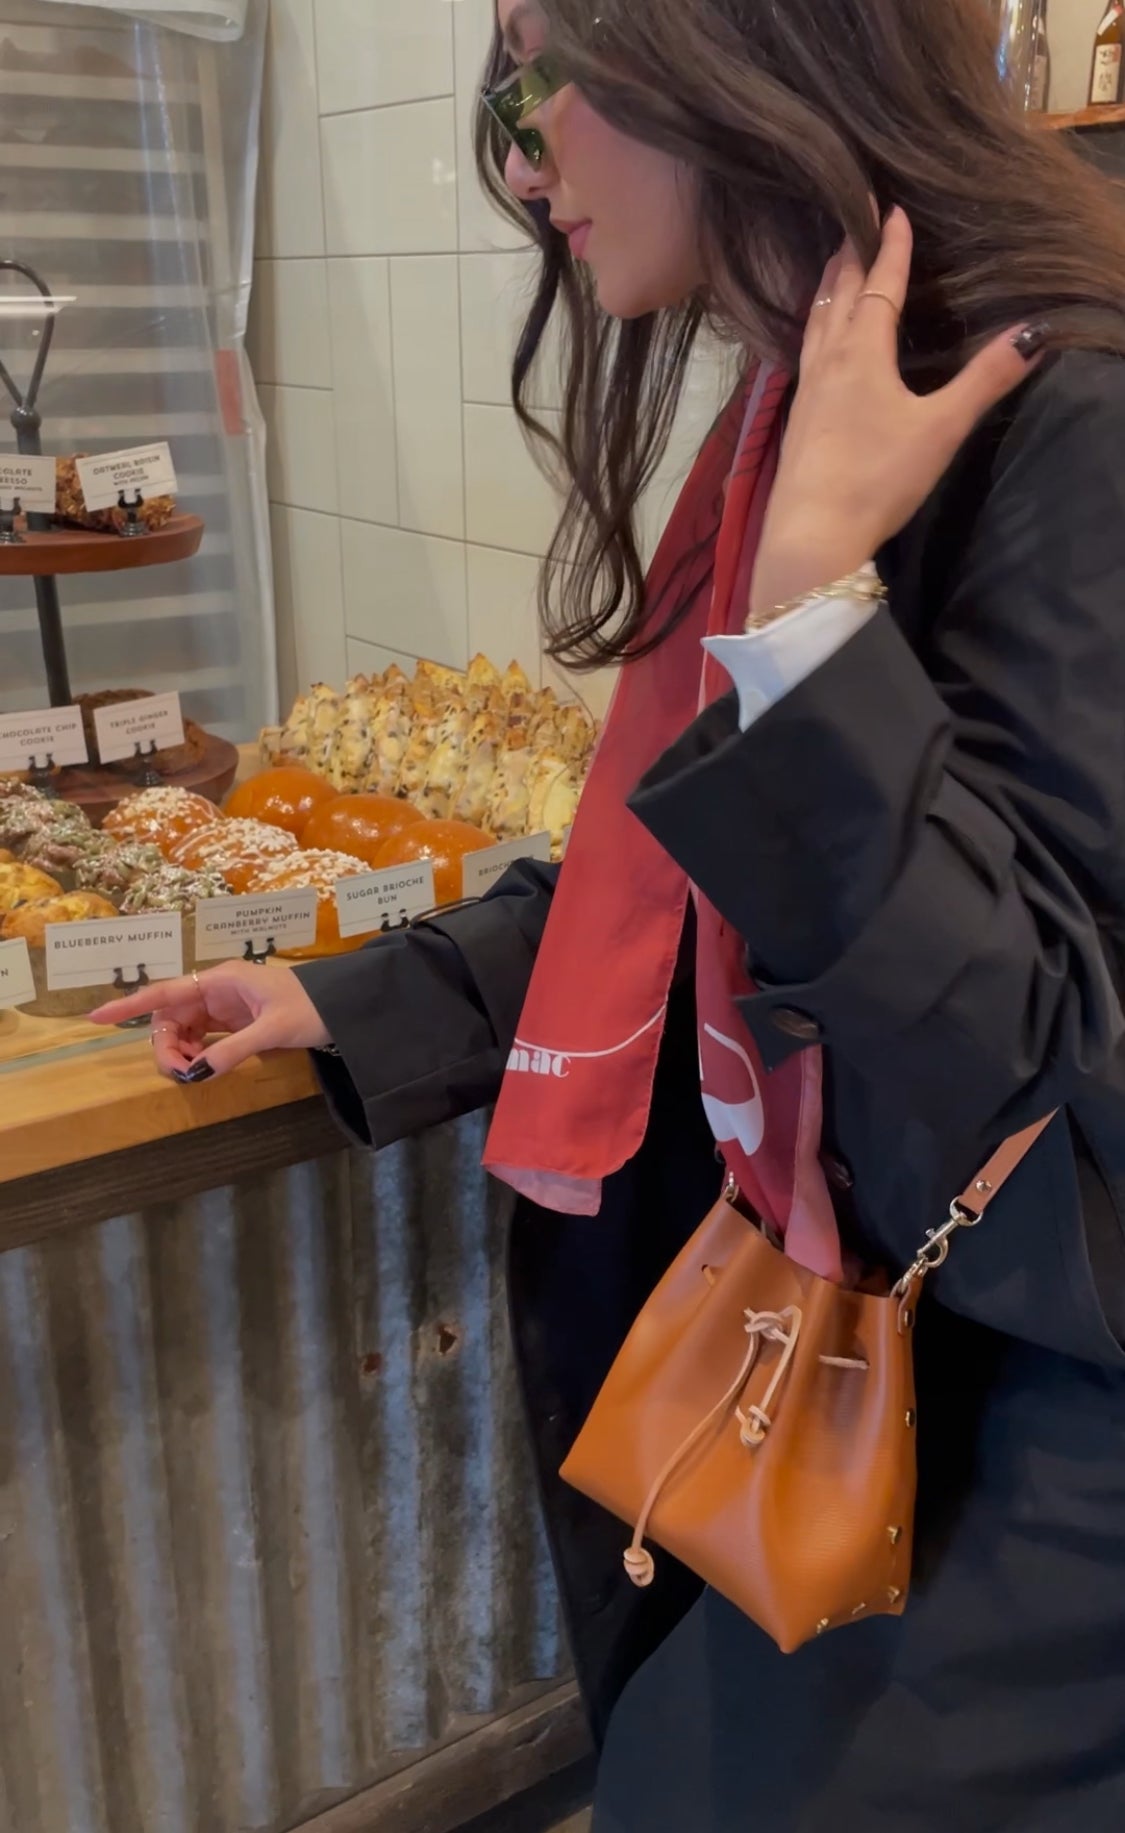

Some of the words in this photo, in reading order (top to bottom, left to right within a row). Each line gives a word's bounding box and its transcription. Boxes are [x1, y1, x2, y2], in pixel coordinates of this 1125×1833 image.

[113, 467, 144, 479] COOKIE
[55, 723, 77, 732] CHIP
[110, 717, 136, 728] TRIPLE
[126, 722, 155, 734] COOKIE
[20, 736, 54, 747] COOKIE
[346, 886, 379, 901] SUGAR
[383, 876, 424, 892] BRIOCHE
[377, 894, 397, 905] BUN
[236, 906, 282, 918] PUMPKIN
[205, 918, 269, 932] CRANBERRY
[272, 911, 310, 923] MUFFIN
[54, 934, 123, 949] BLUEBERRY
[128, 930, 173, 942] MUFFIN
